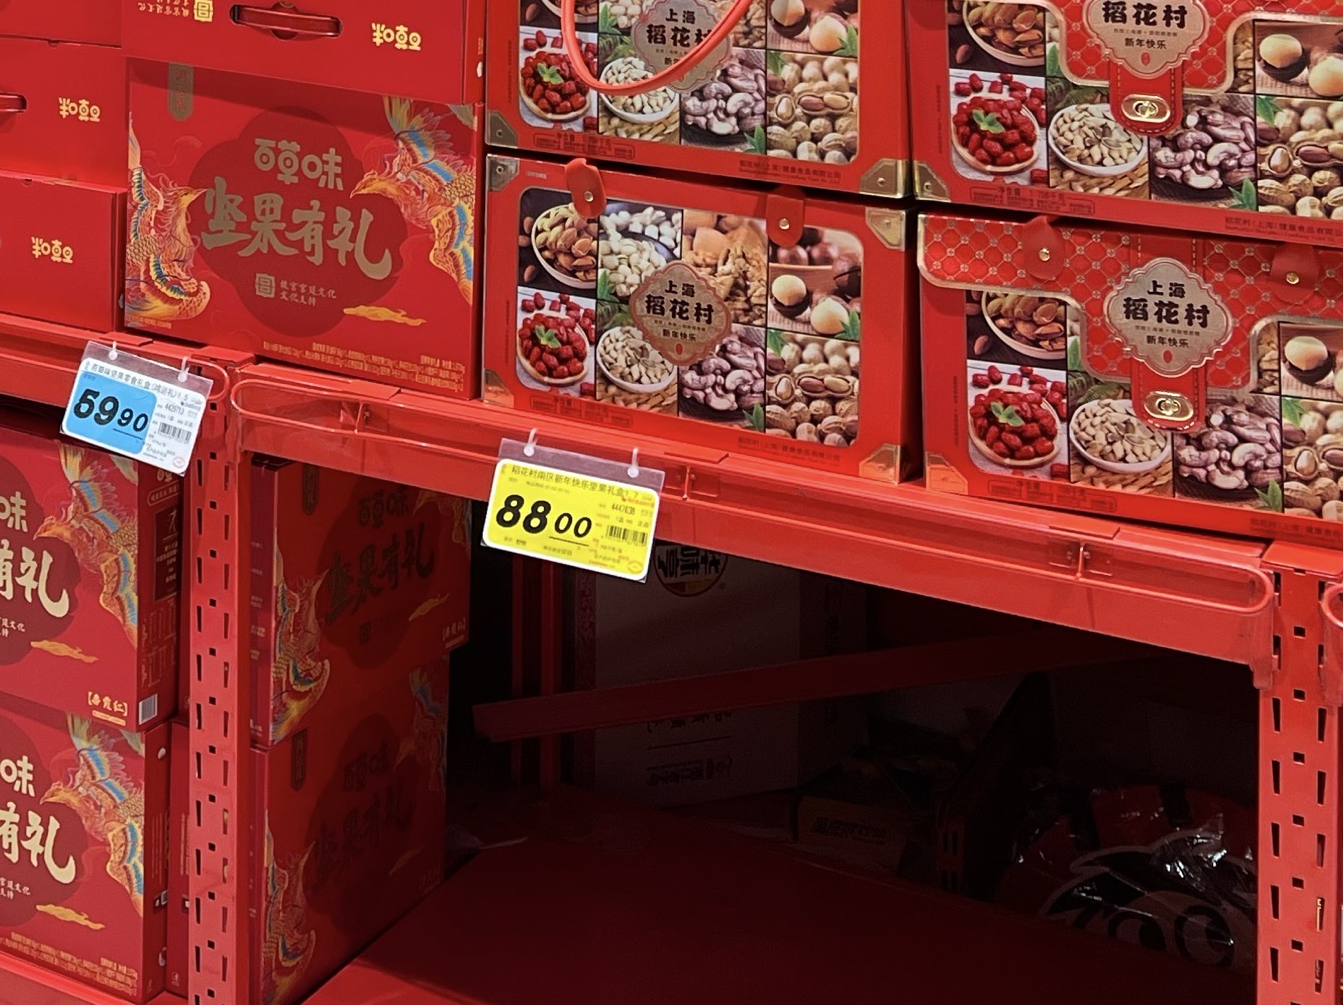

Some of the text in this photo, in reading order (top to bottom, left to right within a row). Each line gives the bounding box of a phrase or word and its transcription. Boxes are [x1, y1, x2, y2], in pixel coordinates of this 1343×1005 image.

[665, 8, 695, 24] 上海
[1102, 0, 1187, 29] 稻花村
[371, 22, 422, 51] 百草味
[1124, 37, 1167, 50] 新年快乐
[59, 98, 101, 122] 百草味
[254, 138, 343, 191] 百草味
[201, 177, 392, 281] 坚果有礼
[31, 236, 73, 264] 百草味
[665, 279, 695, 298] 上海
[1147, 280, 1186, 298] 上海
[645, 294, 714, 325] 稻花村
[1123, 297, 1210, 328] 稻花村
[1146, 335, 1189, 348] 新年快乐
